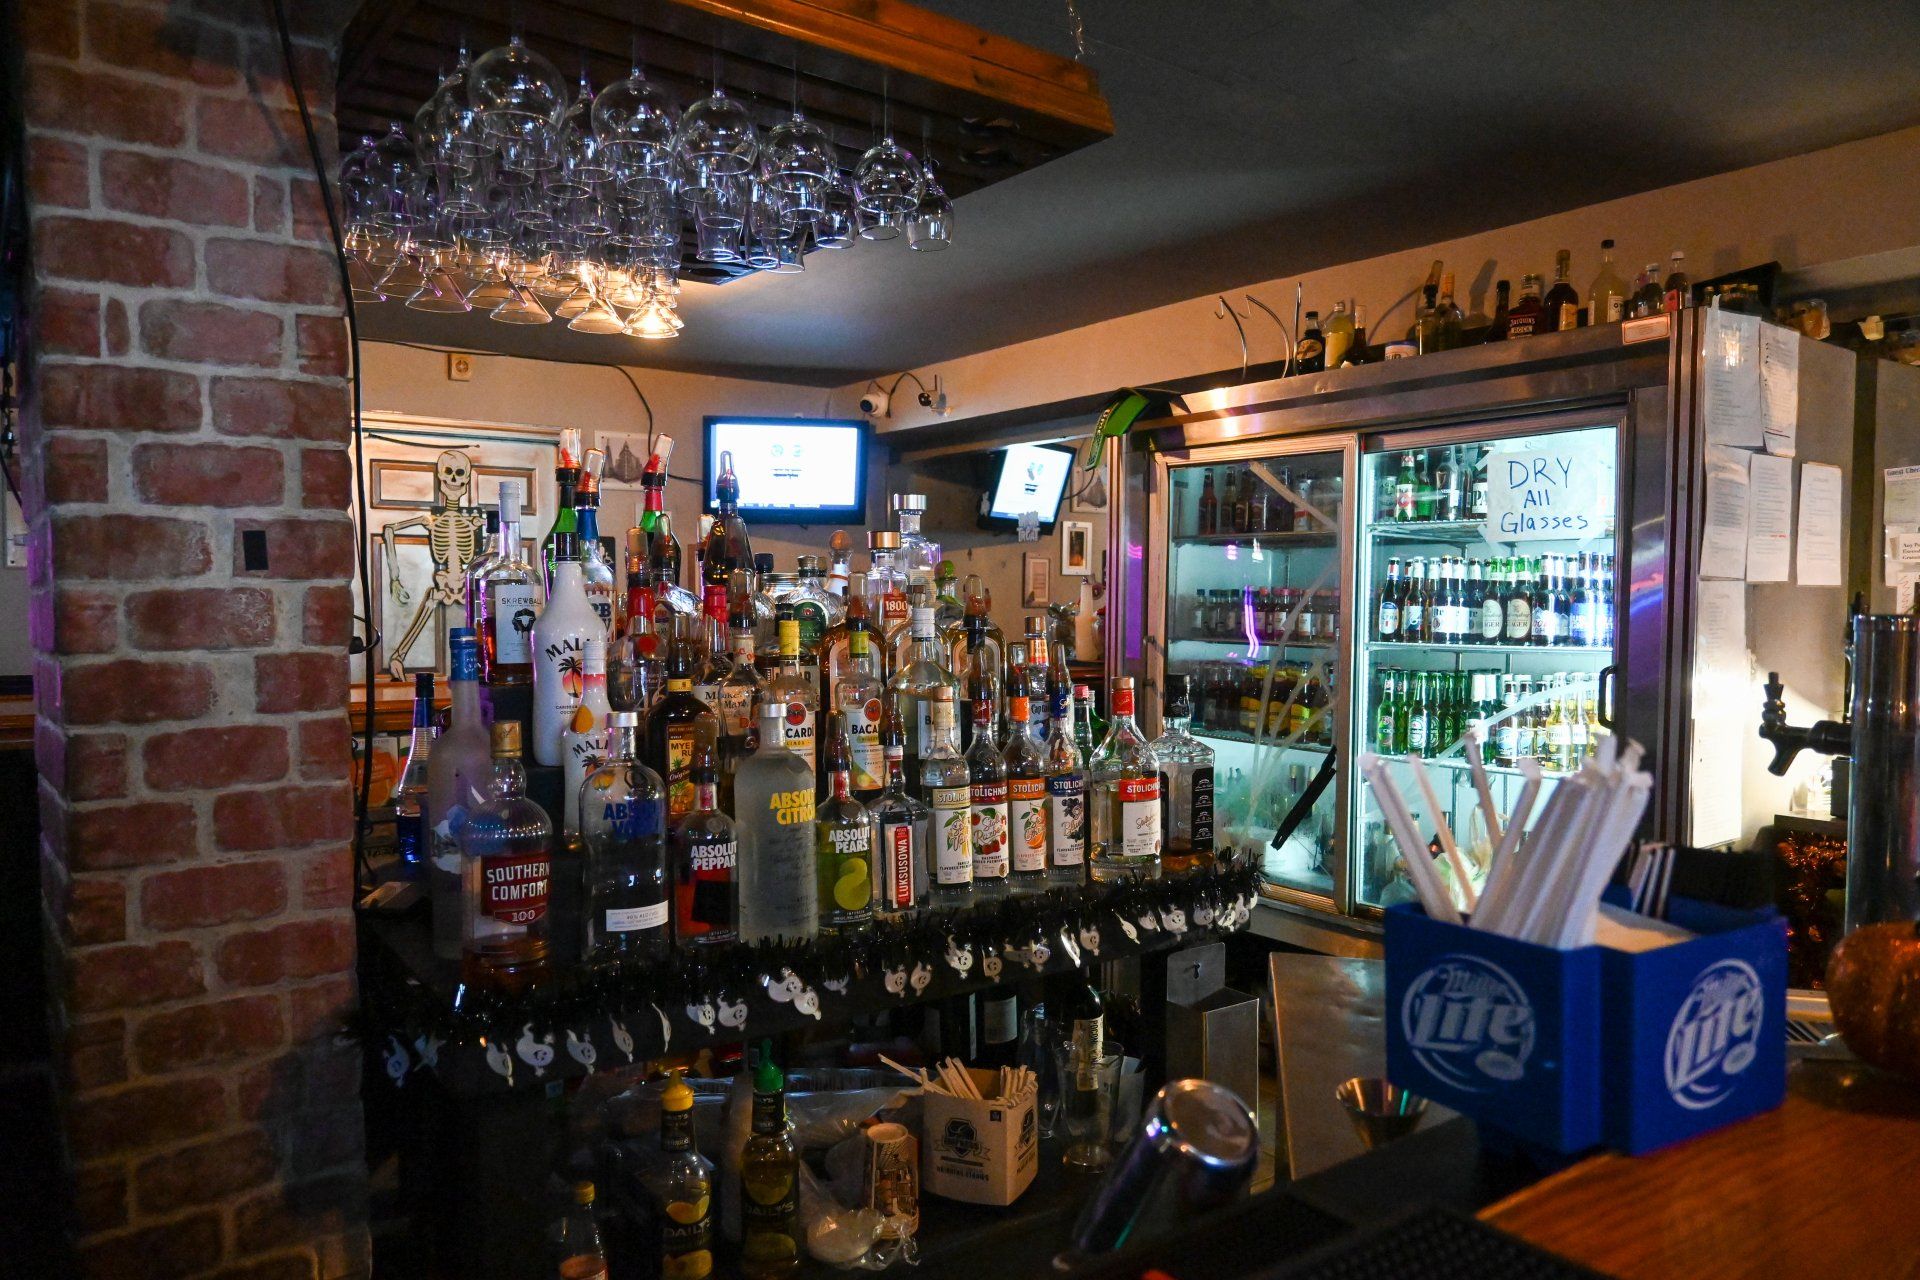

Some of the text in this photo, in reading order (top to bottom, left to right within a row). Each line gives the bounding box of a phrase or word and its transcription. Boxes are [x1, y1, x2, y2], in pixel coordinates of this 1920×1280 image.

[1507, 457, 1573, 490] DRY
[1523, 489, 1551, 508] All
[1500, 511, 1589, 535] Glasses
[885, 600, 907, 612] 1800
[545, 637, 590, 662] MAL
[851, 724, 879, 735] BACA
[828, 826, 871, 842] ABSOLUT
[690, 841, 738, 858] ABSOLUT
[692, 853, 737, 871] PEPPAR
[897, 839, 910, 898] LUKSUSOWA
[486, 862, 550, 884] SOUTHERN
[492, 879, 548, 900] COMFORT
[511, 910, 536, 922] 100
[1413, 992, 1533, 1055] Lite
[1673, 986, 1762, 1093] Lite
